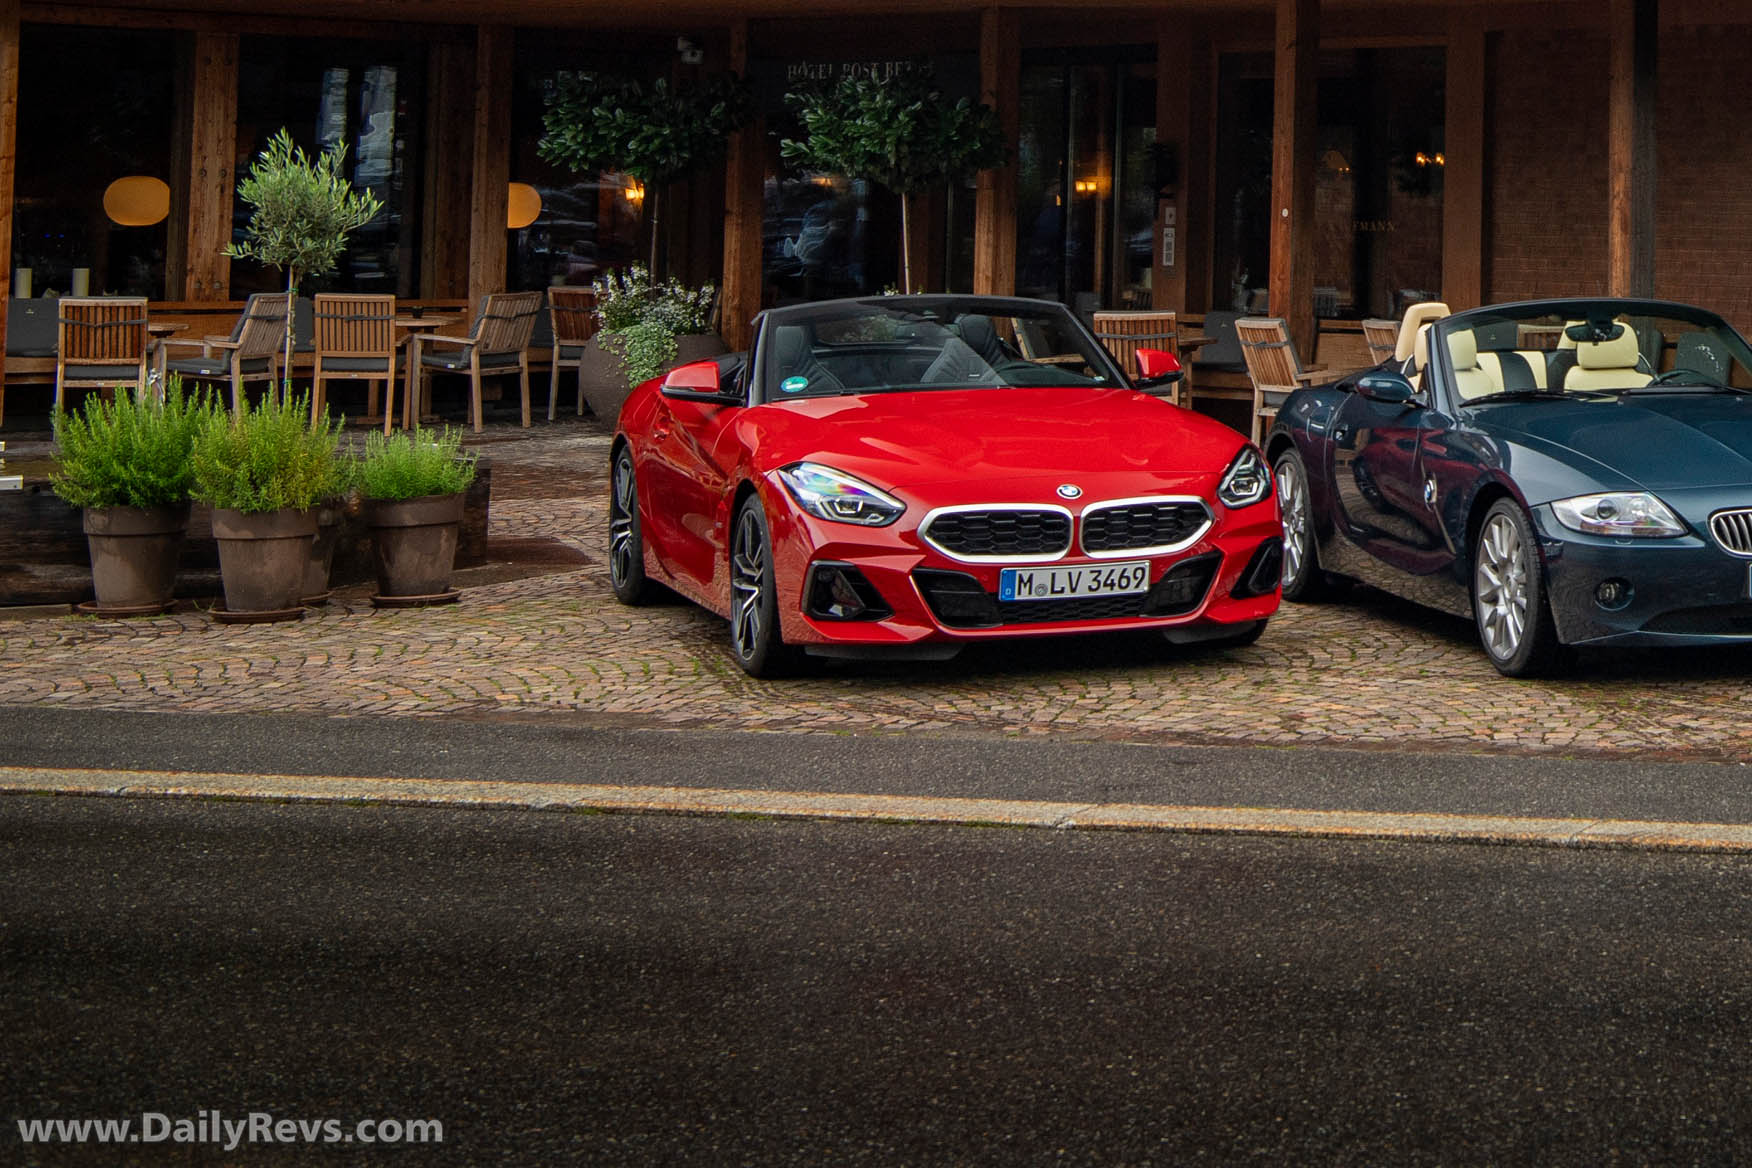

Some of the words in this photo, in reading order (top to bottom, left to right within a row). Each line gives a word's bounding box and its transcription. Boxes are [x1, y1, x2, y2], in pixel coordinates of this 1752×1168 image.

[1017, 573, 1033, 596] M
[1050, 571, 1083, 594] LV
[1088, 567, 1146, 593] 3469
